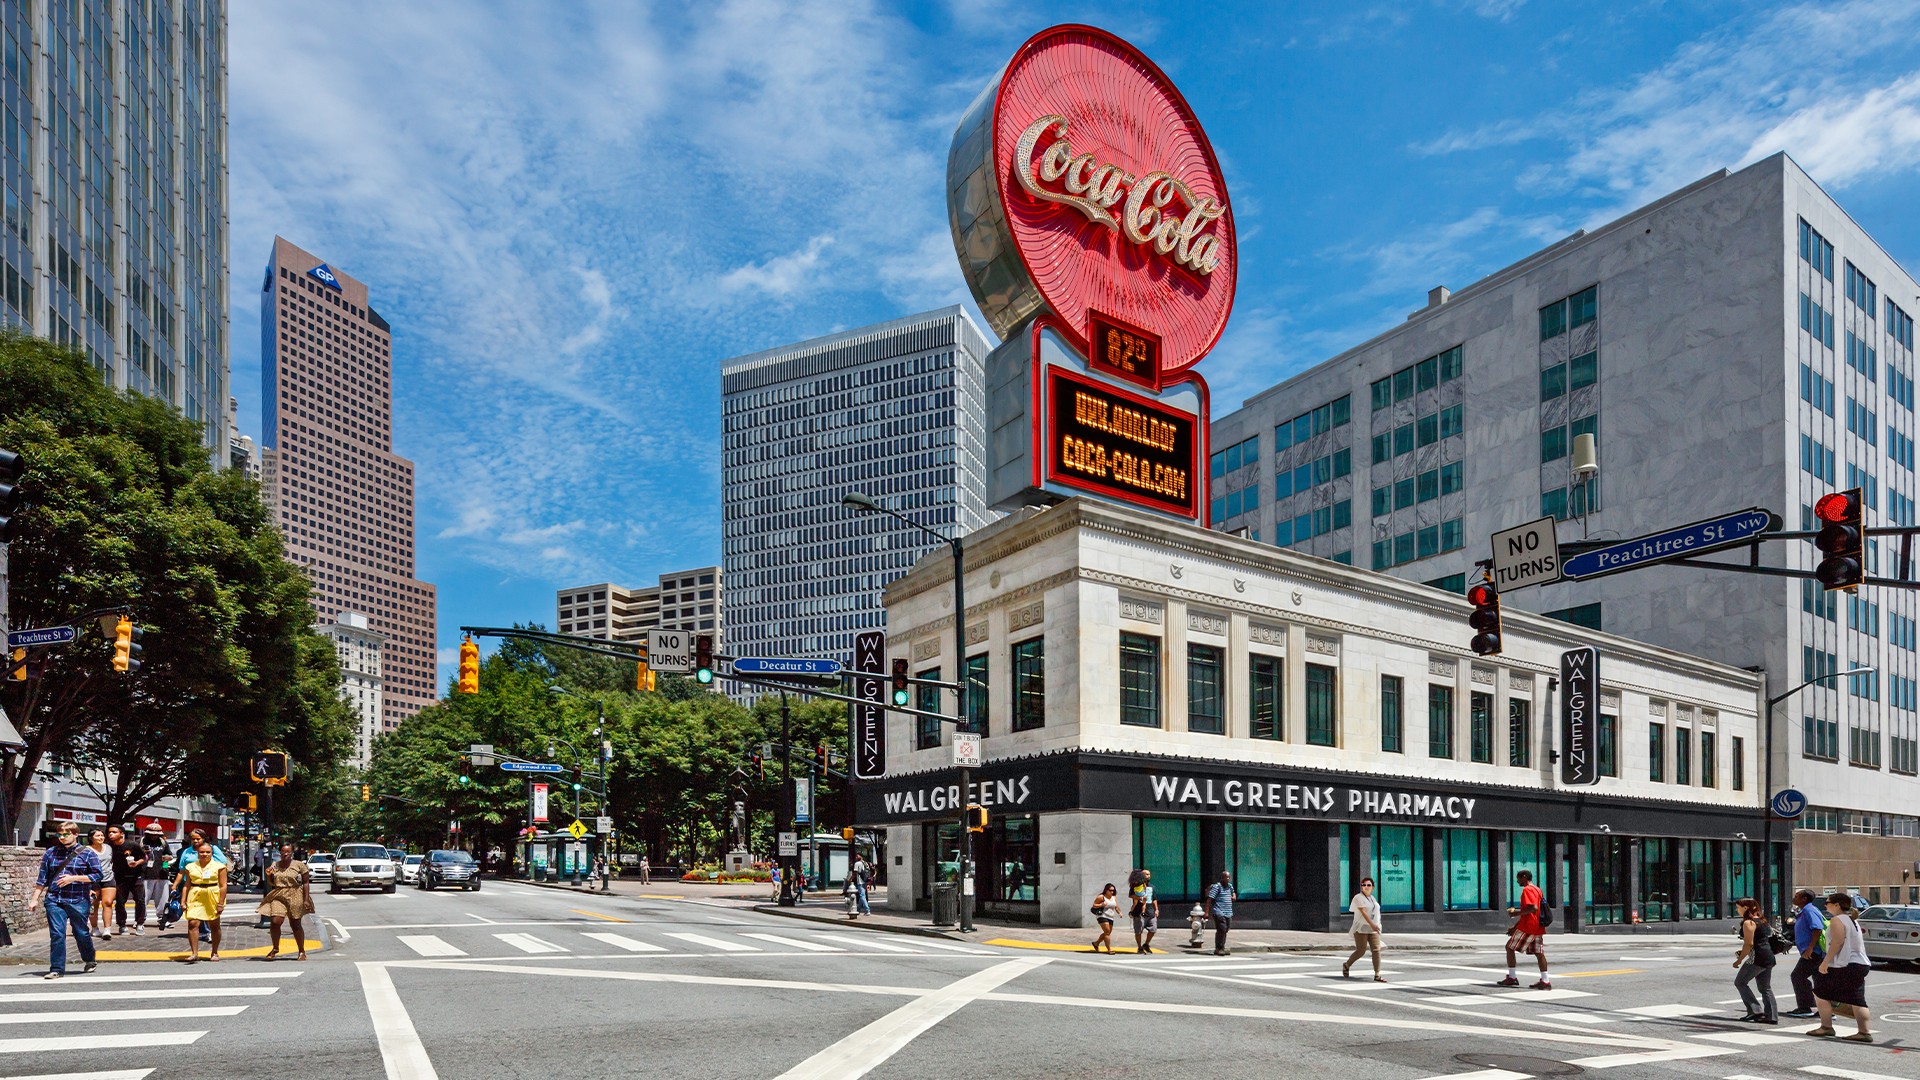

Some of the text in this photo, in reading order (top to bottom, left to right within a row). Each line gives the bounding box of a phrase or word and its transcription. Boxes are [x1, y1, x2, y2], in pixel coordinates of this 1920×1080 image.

[1013, 114, 1227, 276] Coca-Cola
[316, 268, 334, 282] GP
[1063, 434, 1186, 499] COCA-COLA.COM
[1508, 530, 1539, 556] NO
[1598, 516, 1763, 567] Peachtree St NW
[1498, 556, 1555, 584] TURNS
[17, 632, 52, 643] Peachtree
[53, 630, 61, 640] St
[658, 635, 680, 649] NO
[650, 653, 688, 666] TURNS
[759, 660, 802, 671] Decatur
[805, 661, 817, 671] St
[1566, 652, 1588, 780] WALGREENS
[968, 757, 978, 765] BOX
[1150, 775, 1476, 819] WALGREENS PHARMACY
